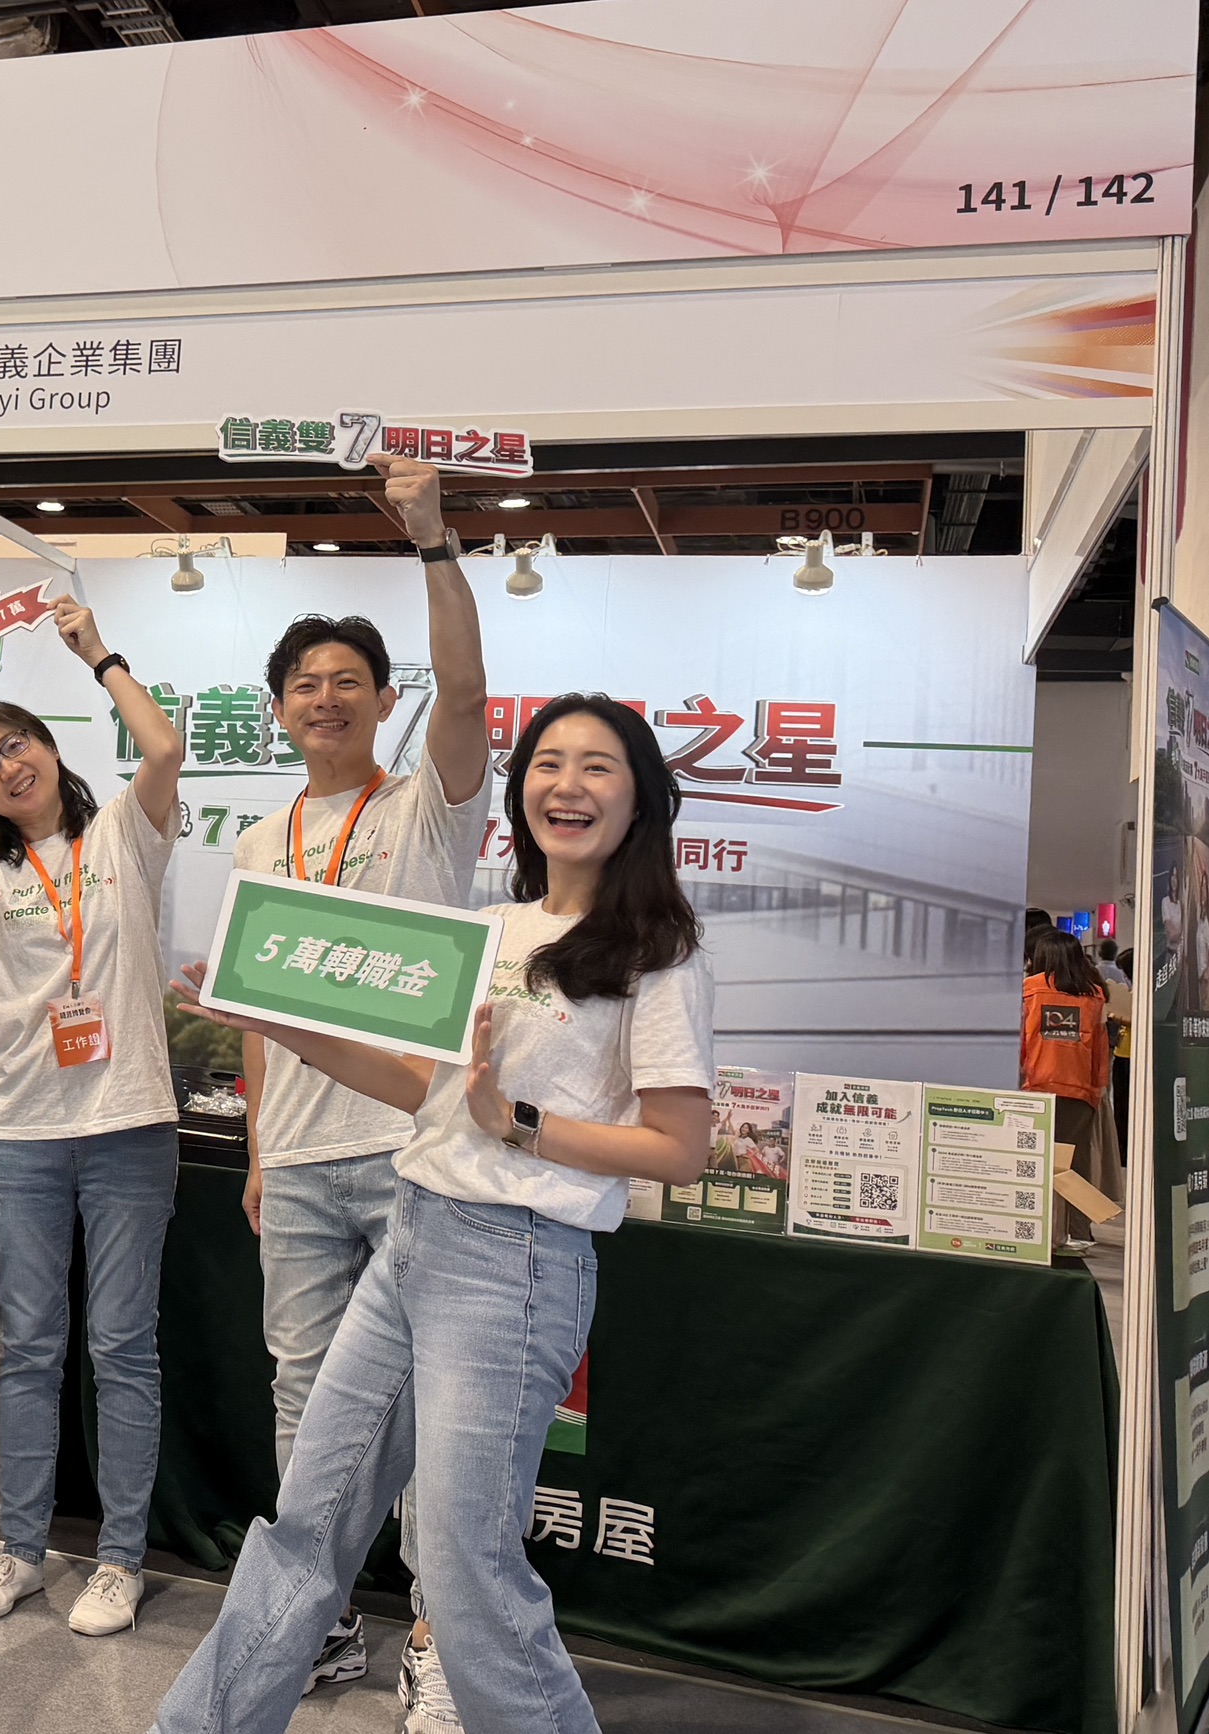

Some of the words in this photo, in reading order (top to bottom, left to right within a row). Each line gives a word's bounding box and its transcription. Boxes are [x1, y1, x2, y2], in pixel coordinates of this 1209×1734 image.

[956, 180, 1032, 214] 141
[1044, 174, 1063, 216] /
[1076, 172, 1155, 207] 142
[28, 386, 112, 414] Group
[3, 904, 50, 921] create
[494, 960, 520, 971] ou
[489, 983, 508, 996] he
[1044, 1011, 1077, 1028] 104
[825, 1089, 879, 1106] 加入信義
[815, 1101, 898, 1120] 成就無限可能
